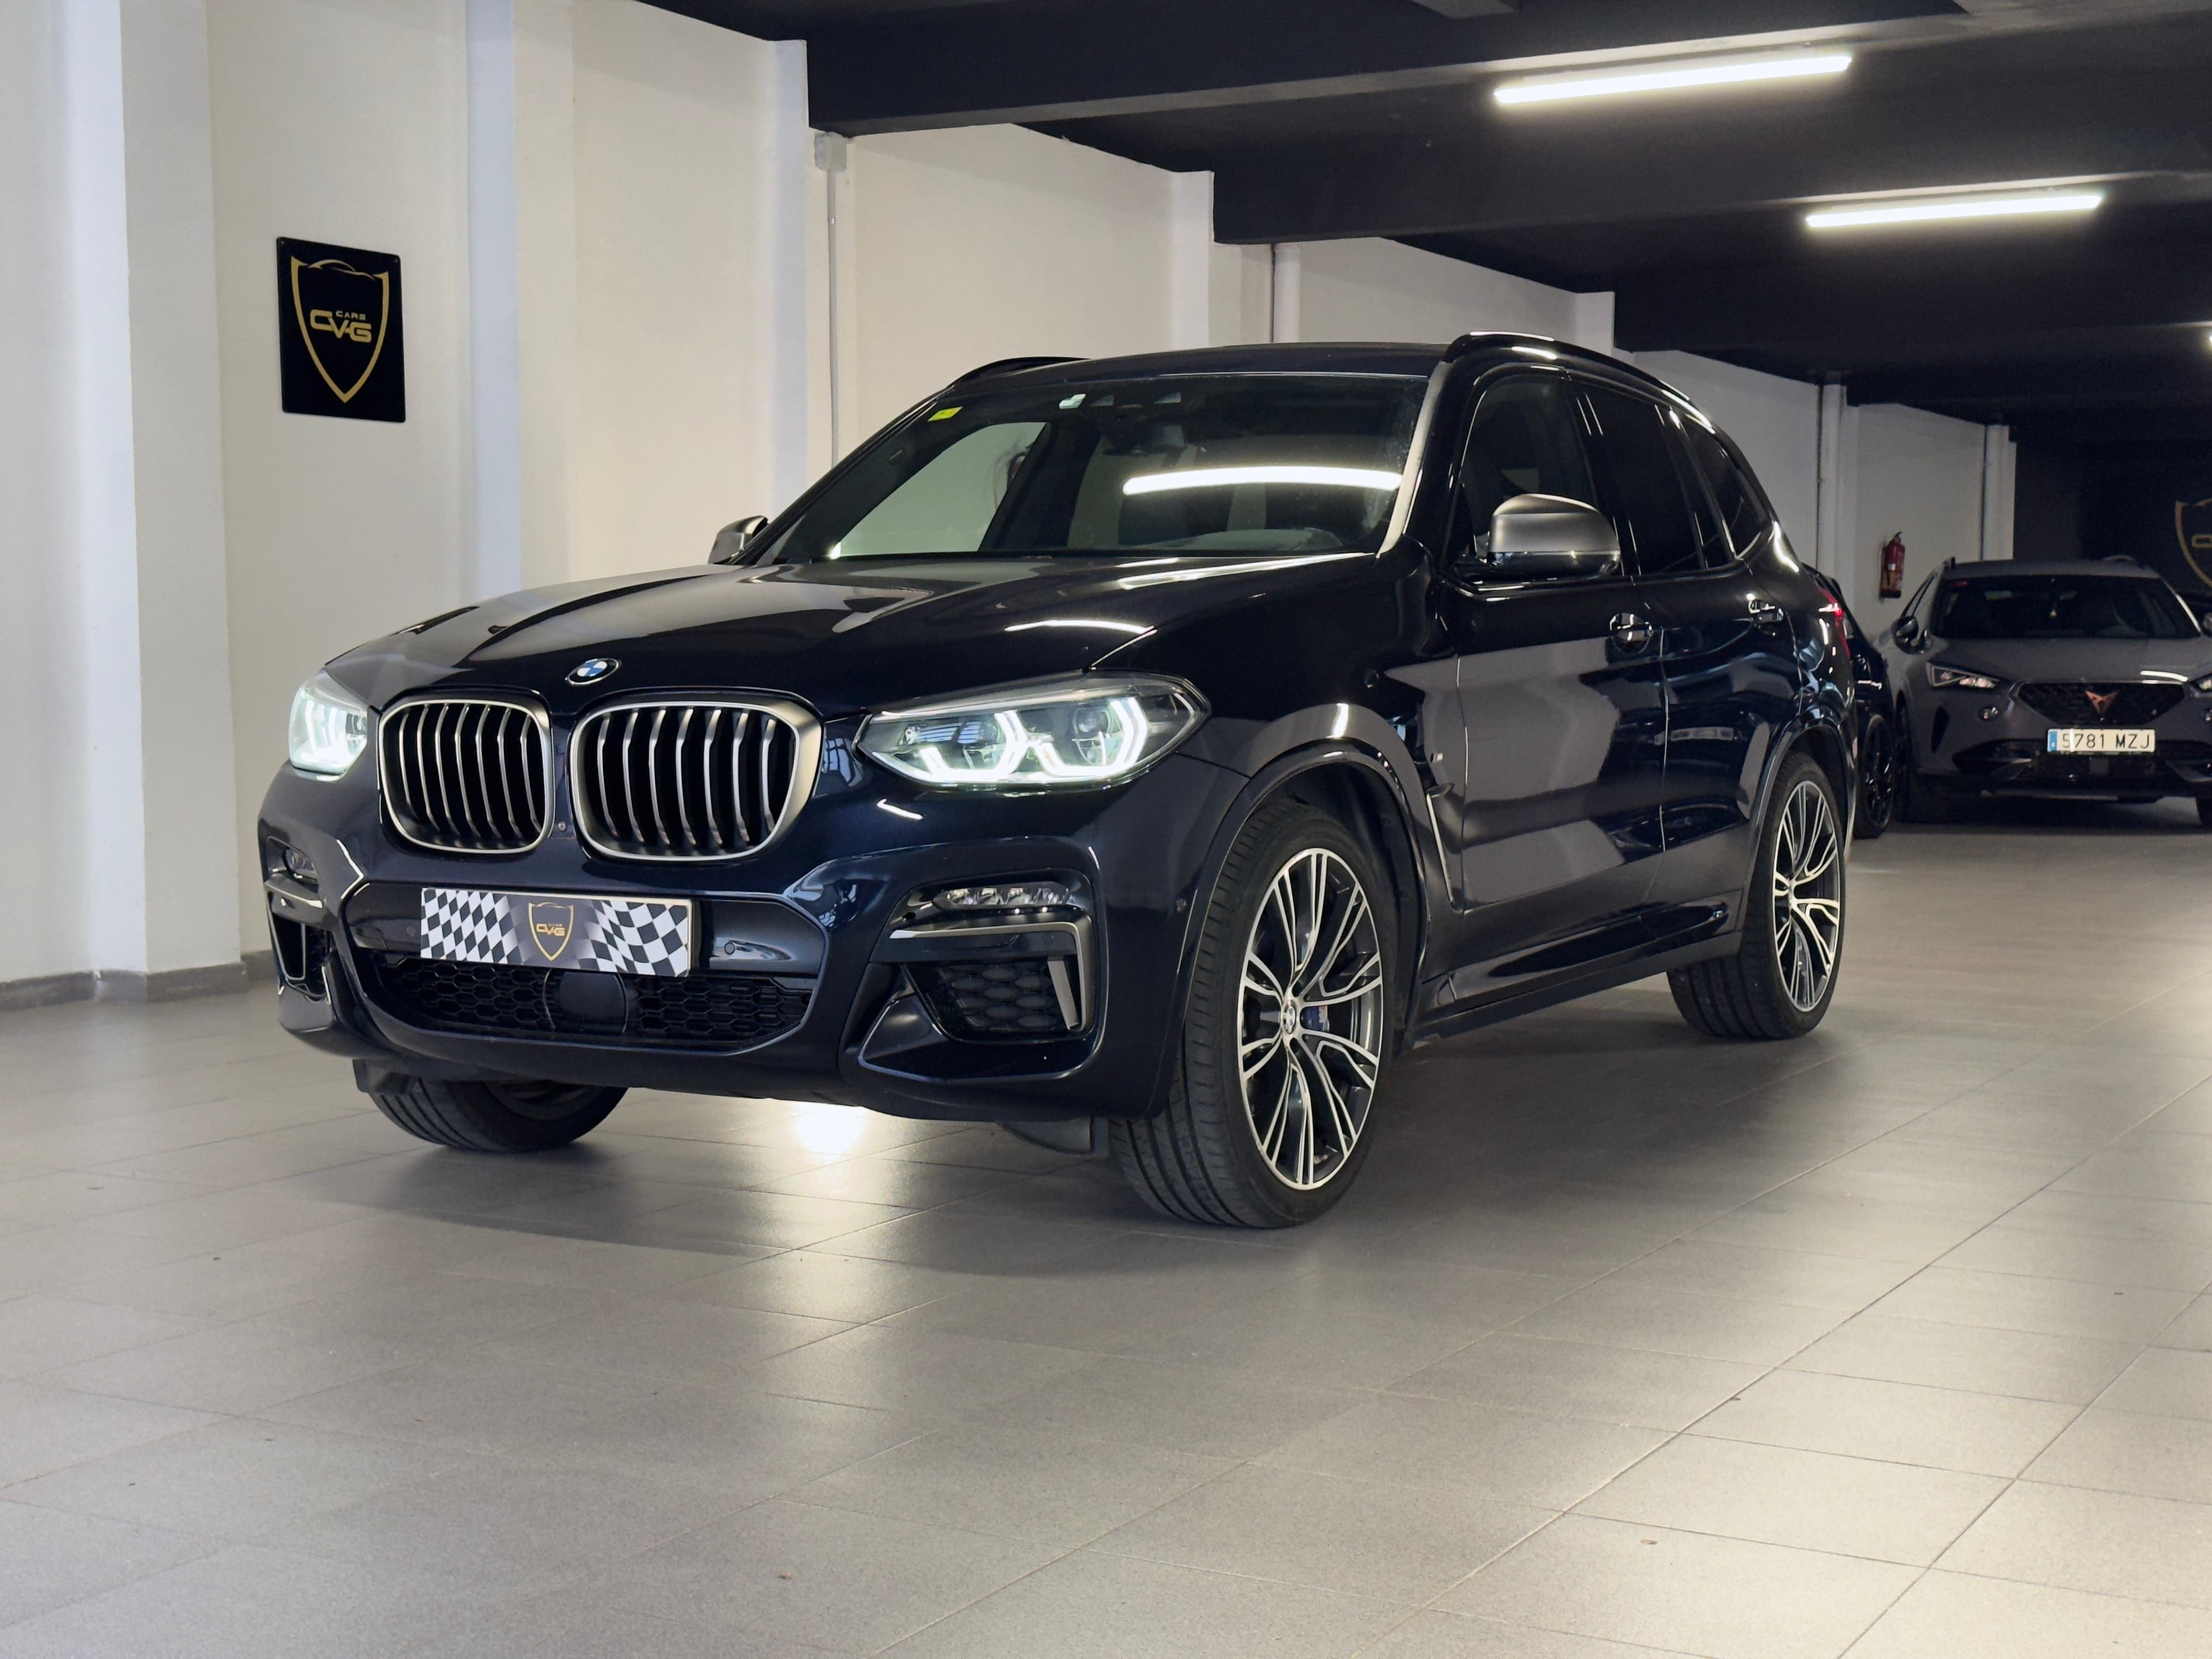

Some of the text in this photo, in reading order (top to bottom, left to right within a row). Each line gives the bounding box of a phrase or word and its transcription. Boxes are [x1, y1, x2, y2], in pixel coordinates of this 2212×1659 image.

[336, 310, 366, 320] CARS
[310, 309, 372, 343] CVG
[2062, 733, 2150, 749] 5781 MZJ
[536, 923, 565, 936] CVG
